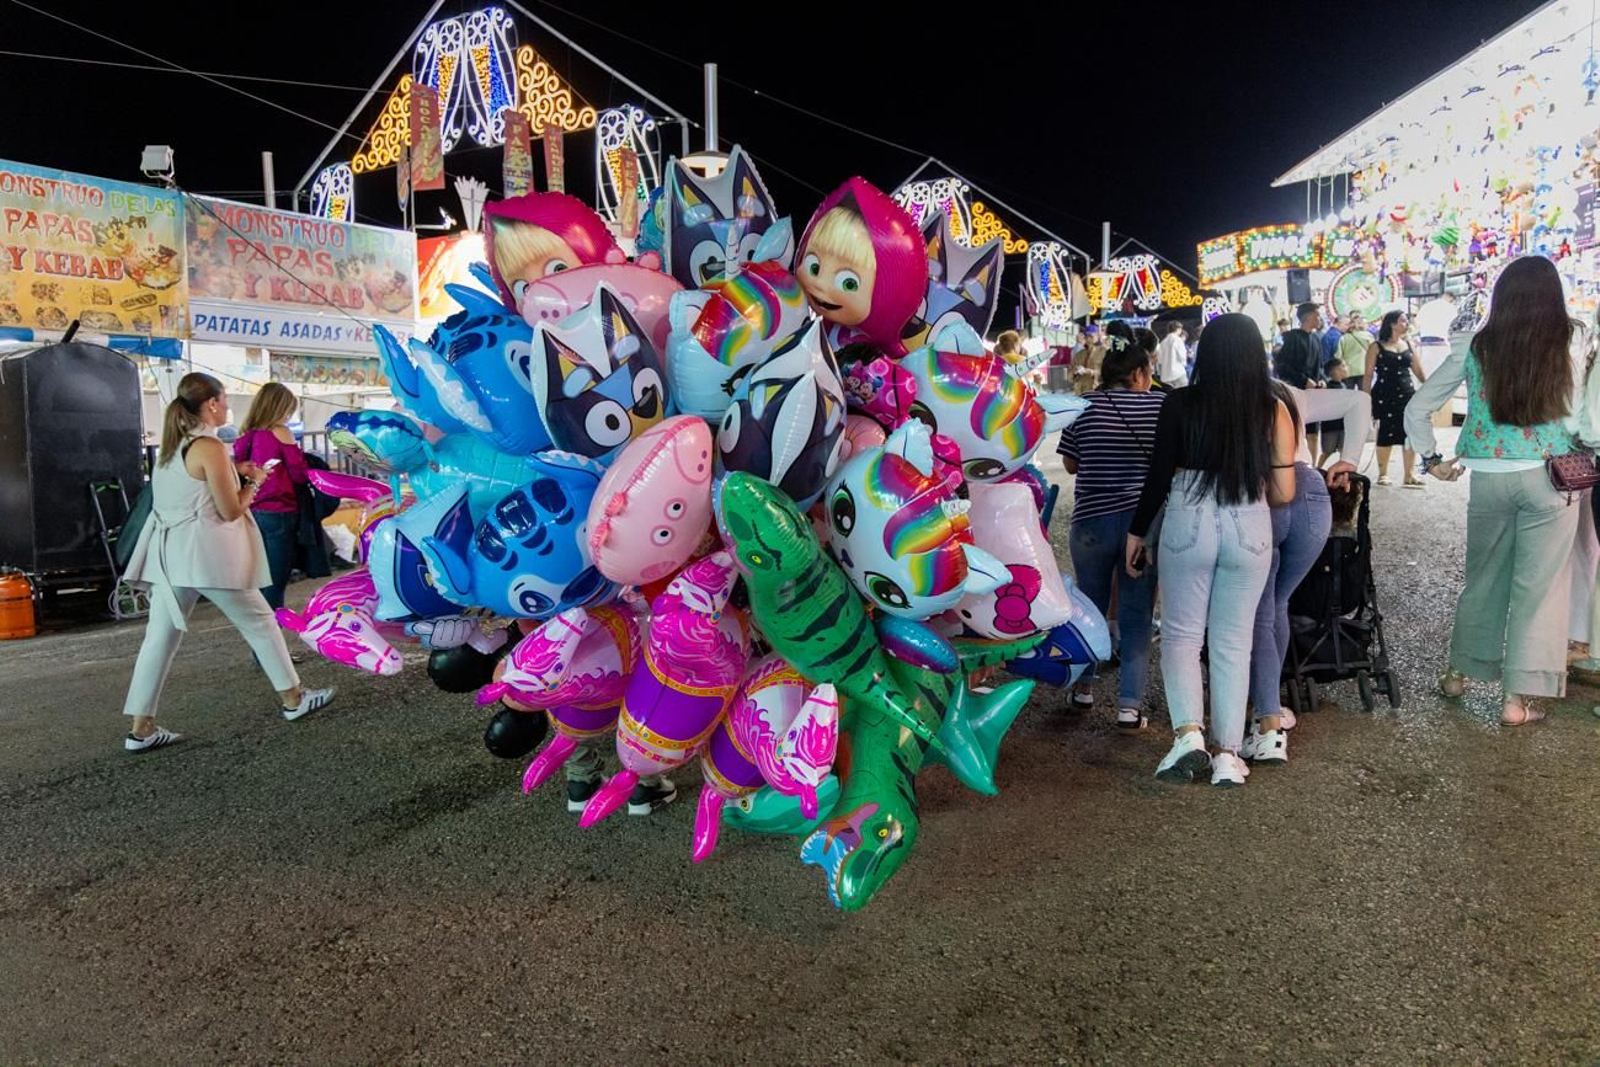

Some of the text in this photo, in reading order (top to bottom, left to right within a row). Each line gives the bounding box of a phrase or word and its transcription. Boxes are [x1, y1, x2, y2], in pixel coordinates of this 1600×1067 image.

[3, 208, 94, 245] PAPAS
[213, 203, 345, 248] MONSTRUO
[6, 246, 125, 281] Y KEBAB
[226, 239, 334, 277] PAPAS
[244, 274, 365, 310] Y KEBAB
[195, 314, 272, 336] PATATAS
[280, 322, 341, 341] ASADAS
